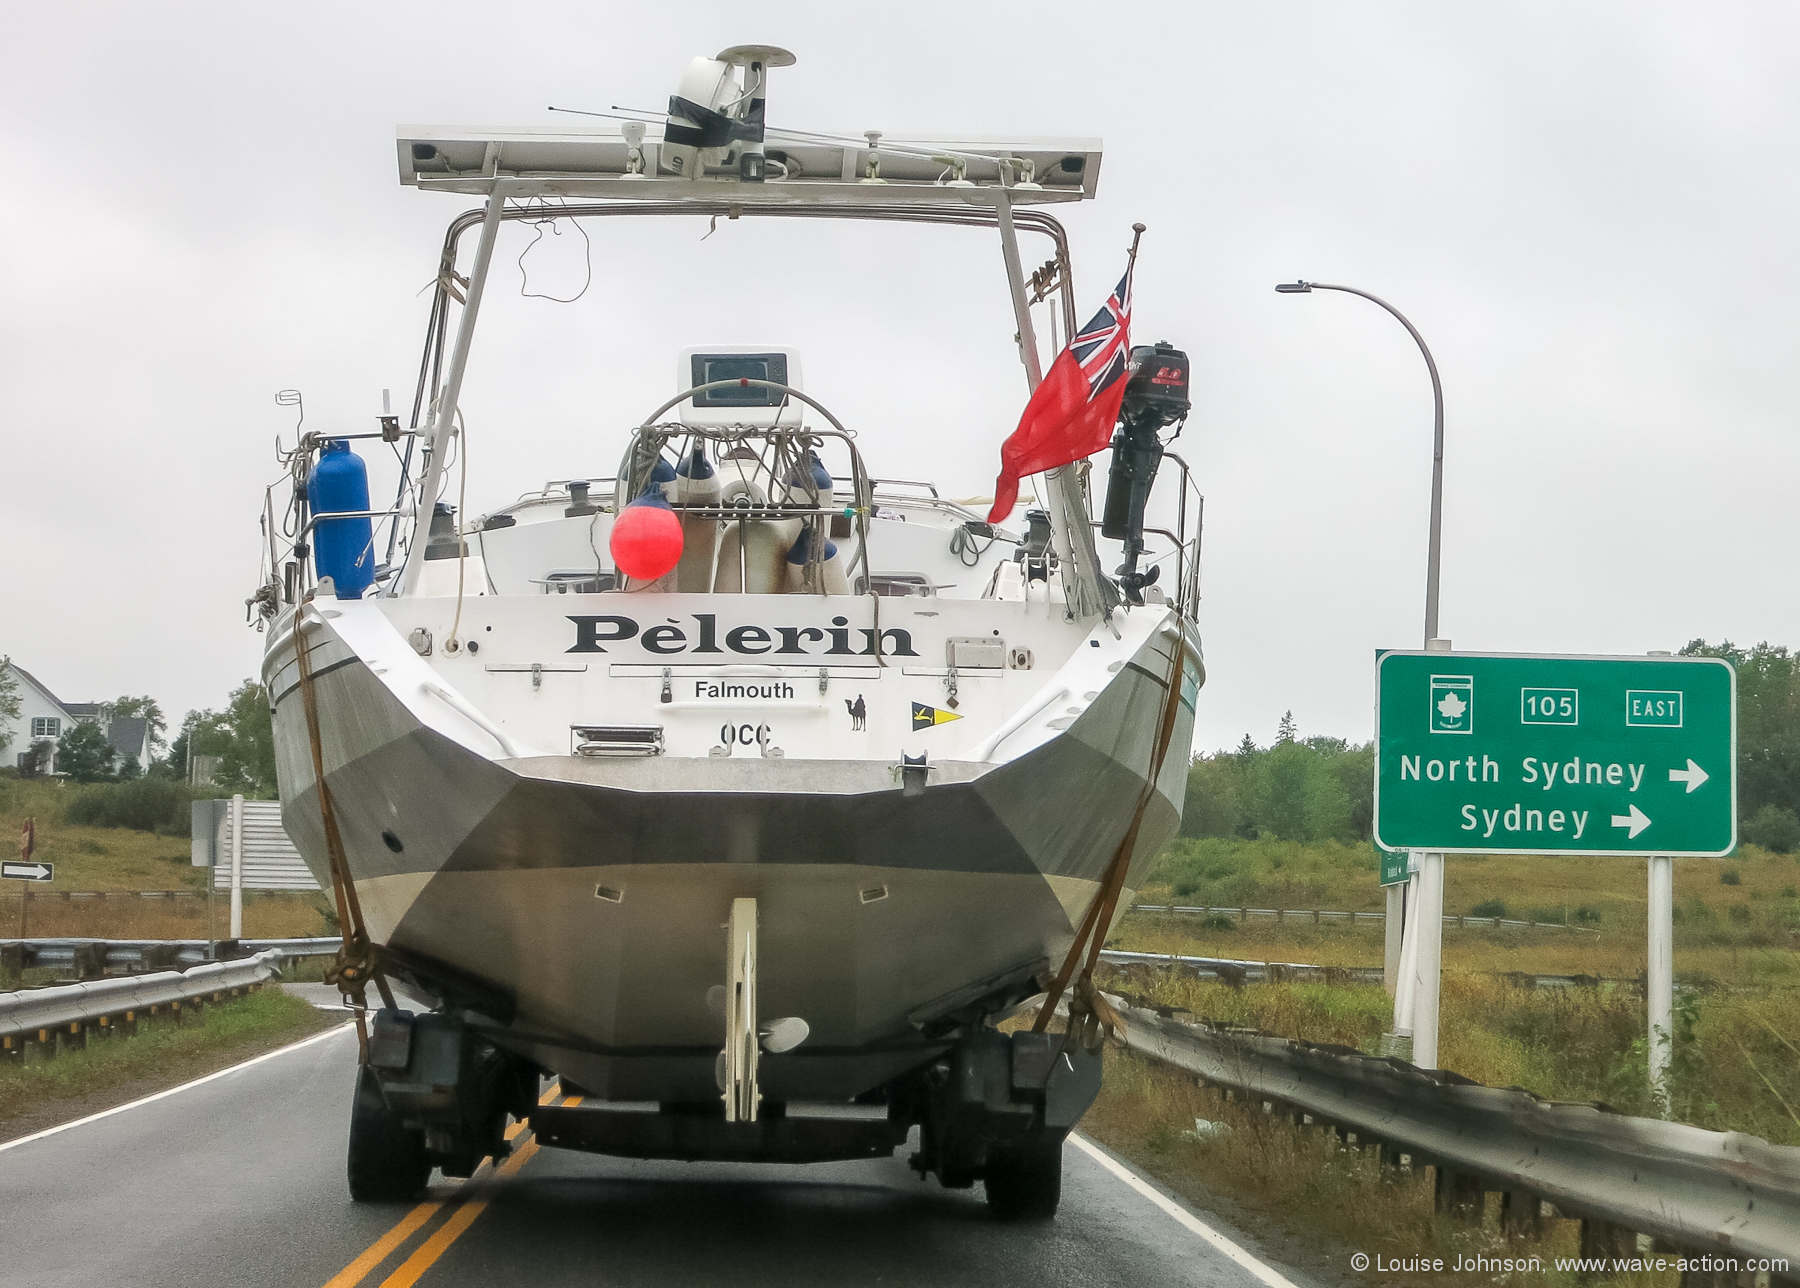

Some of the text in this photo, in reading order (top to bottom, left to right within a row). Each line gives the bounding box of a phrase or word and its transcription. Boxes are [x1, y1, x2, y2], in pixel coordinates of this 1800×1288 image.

[564, 613, 921, 657] Pèlerin
[695, 681, 794, 700] Falmouth
[1527, 696, 1573, 717] 105
[1633, 700, 1676, 717] EAST
[721, 724, 770, 745] OCC
[1401, 754, 1646, 792] North Sydney
[1461, 803, 1588, 839] Sydney
